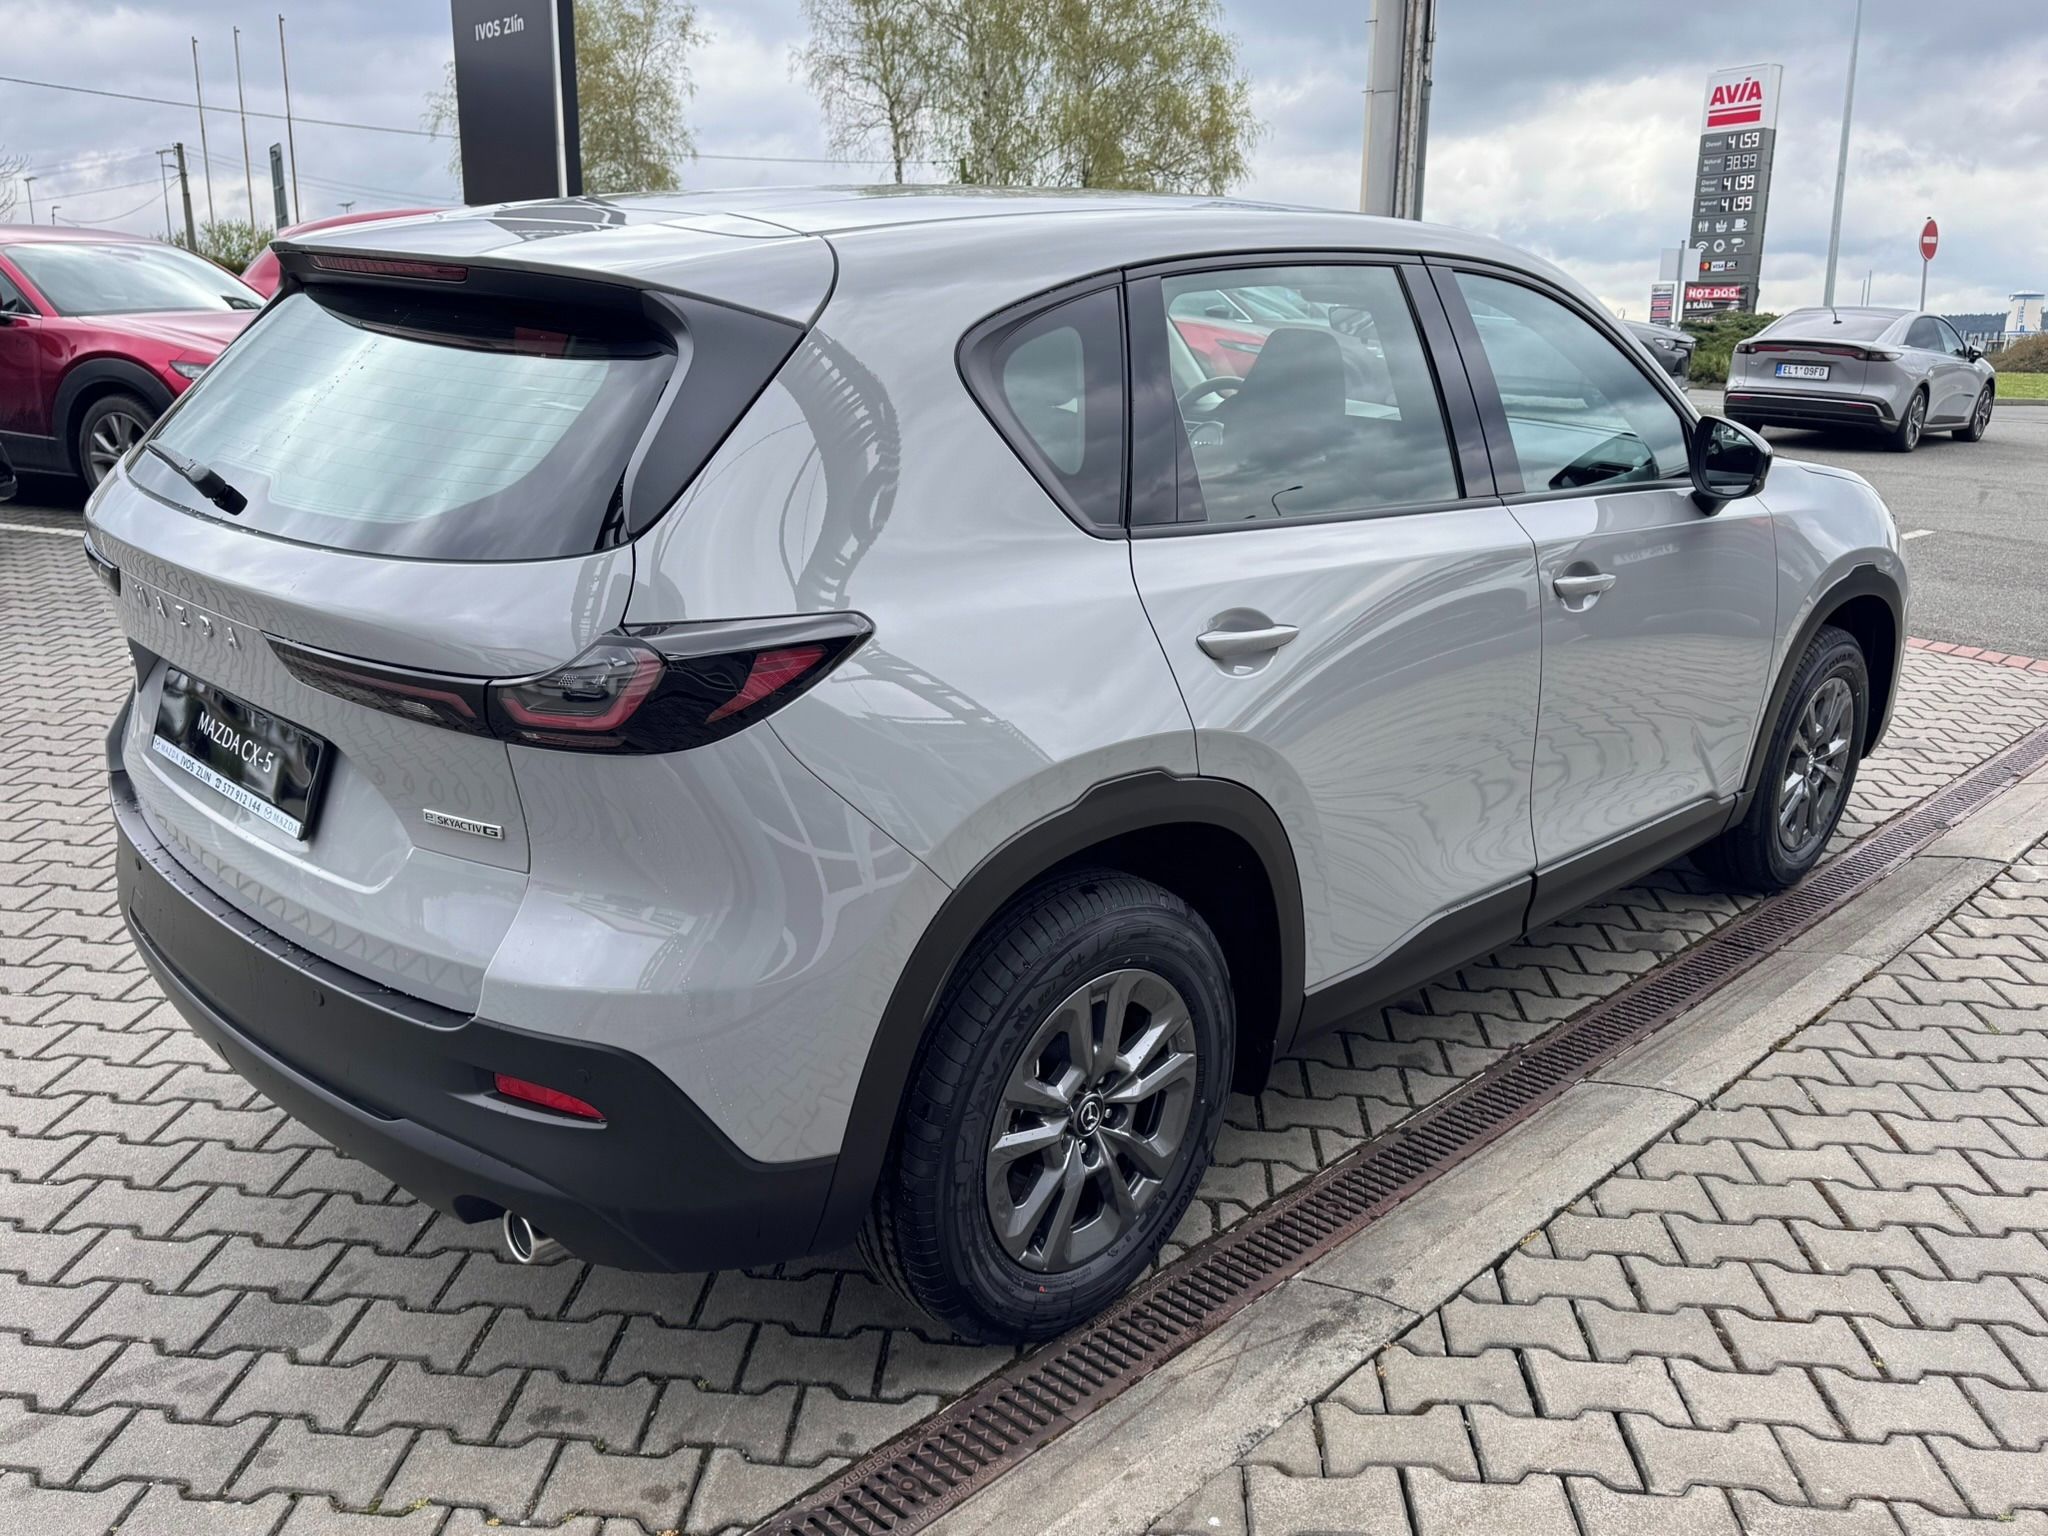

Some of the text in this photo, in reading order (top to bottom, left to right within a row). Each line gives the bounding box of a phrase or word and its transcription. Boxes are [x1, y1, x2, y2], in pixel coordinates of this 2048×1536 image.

[475, 13, 525, 41] IVOS Zlín
[1688, 287, 1737, 299] HOT DOG
[1693, 299, 1714, 309] KÁVA
[134, 584, 242, 651] MAZDA
[197, 711, 274, 774] MAZDA CX-5
[160, 742, 180, 762] MAZDA
[180, 755, 195, 773] IVOS
[222, 782, 235, 796] 577
[235, 789, 247, 805] 912
[249, 798, 262, 814] 144
[272, 813, 299, 834] MAZDA
[1147, 1161, 1206, 1253] YOKOHAMA
[839, 1448, 902, 1489] FASERFIX
[915, 1477, 976, 1523] FASERFIX
